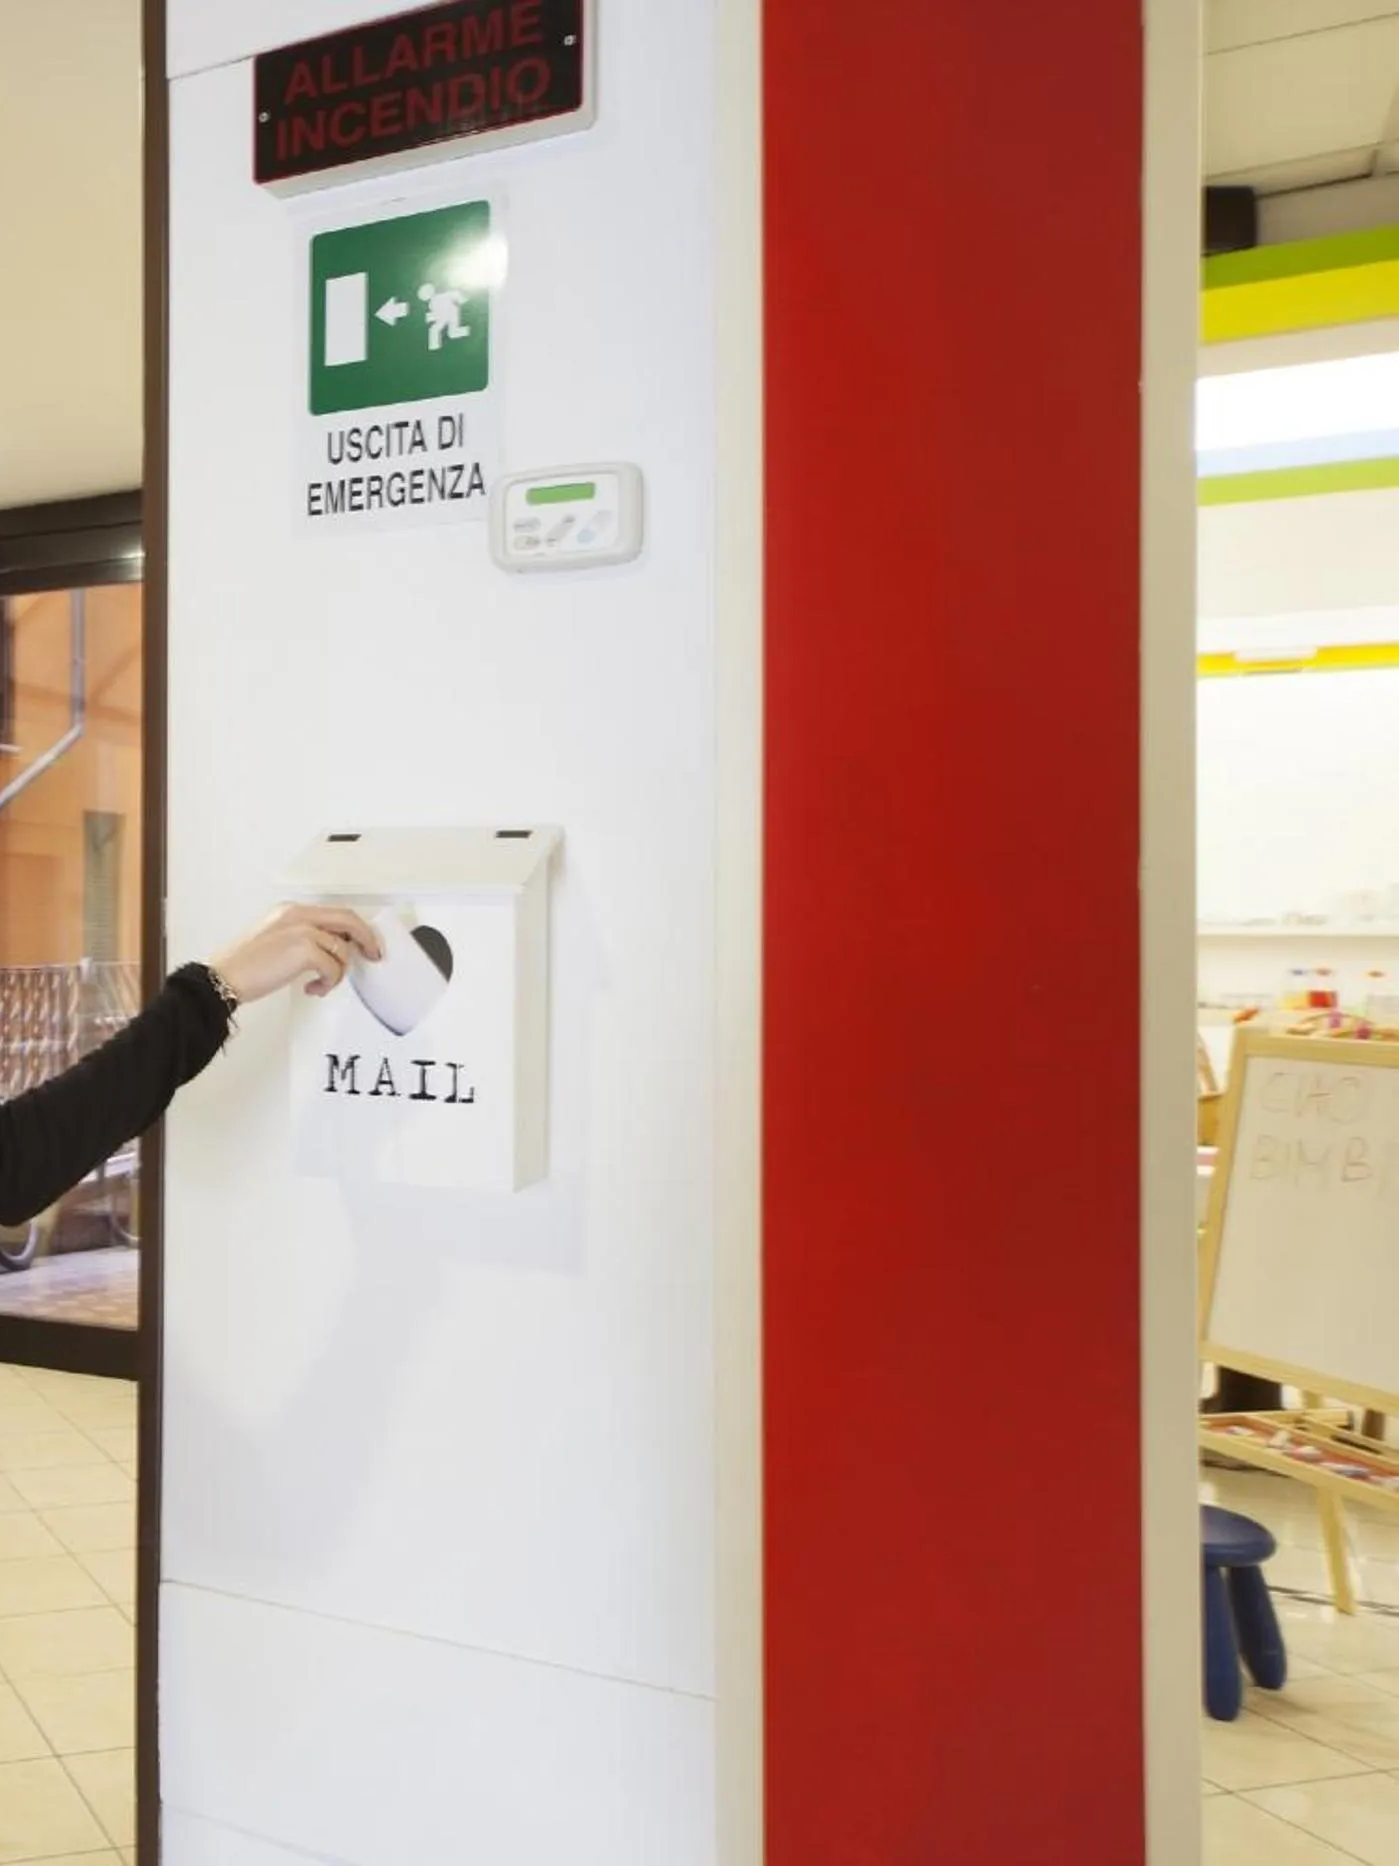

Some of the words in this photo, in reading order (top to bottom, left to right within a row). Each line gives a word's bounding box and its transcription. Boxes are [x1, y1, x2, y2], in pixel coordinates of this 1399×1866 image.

[284, 2, 544, 104] ALLARME
[276, 57, 552, 161] INCENDIO
[327, 420, 428, 465] USCITA
[438, 413, 464, 450] DI
[307, 462, 486, 516] EMERGENZA
[324, 1053, 475, 1104] MAIL
